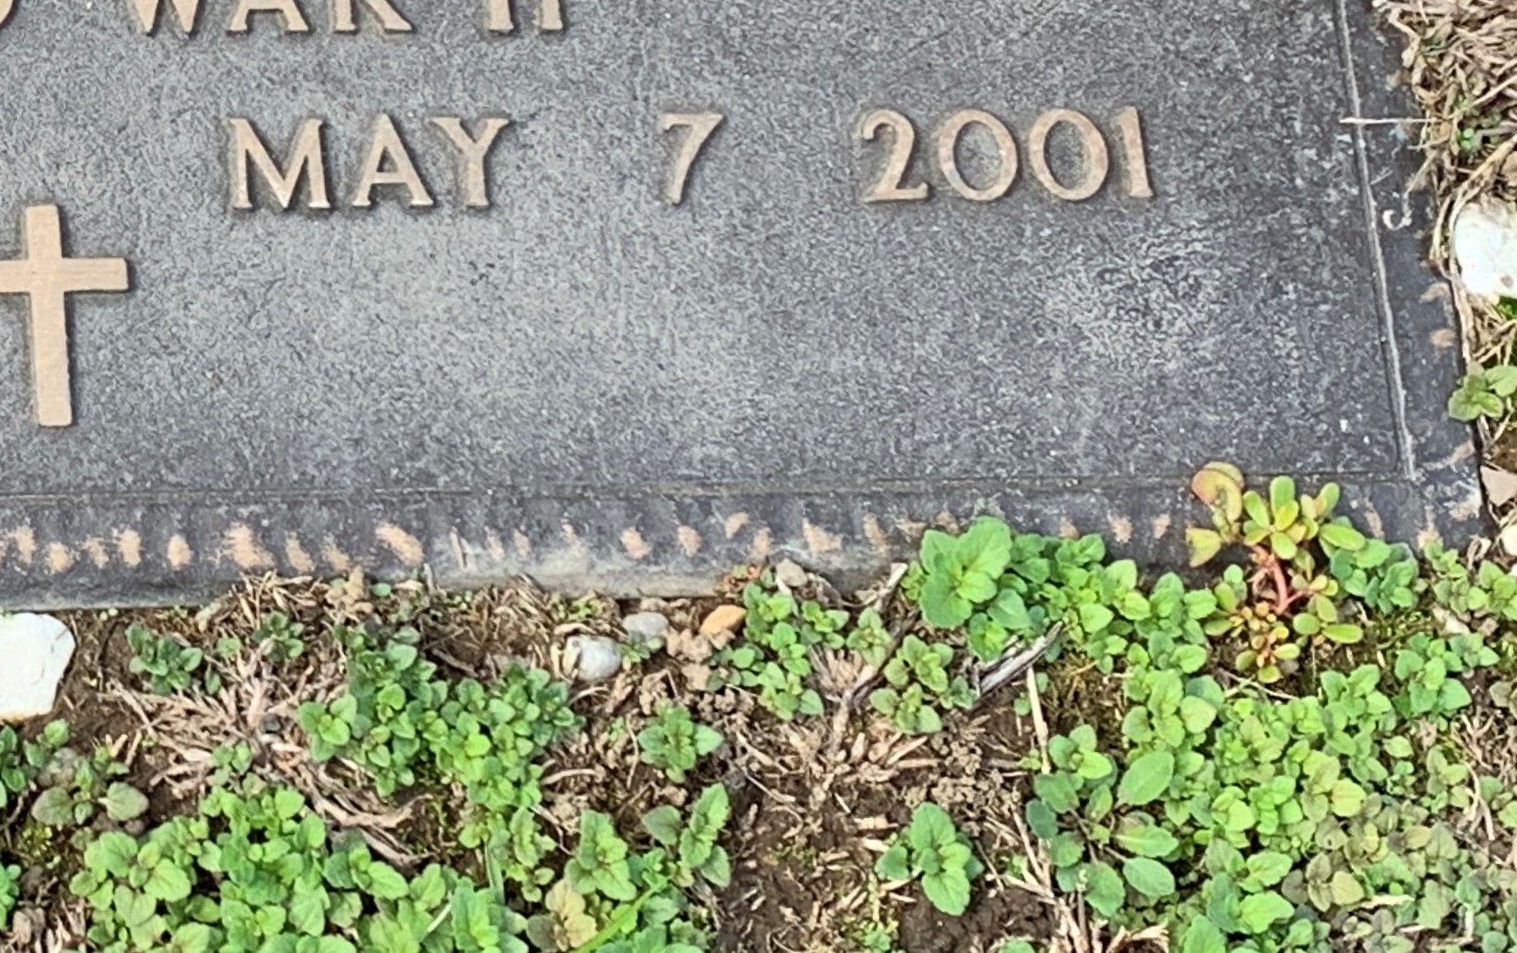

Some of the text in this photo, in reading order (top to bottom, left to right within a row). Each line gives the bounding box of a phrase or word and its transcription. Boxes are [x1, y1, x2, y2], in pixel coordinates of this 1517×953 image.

[227, 114, 511, 211] MAY
[657, 111, 723, 205] 7
[860, 105, 1154, 204] 2001
